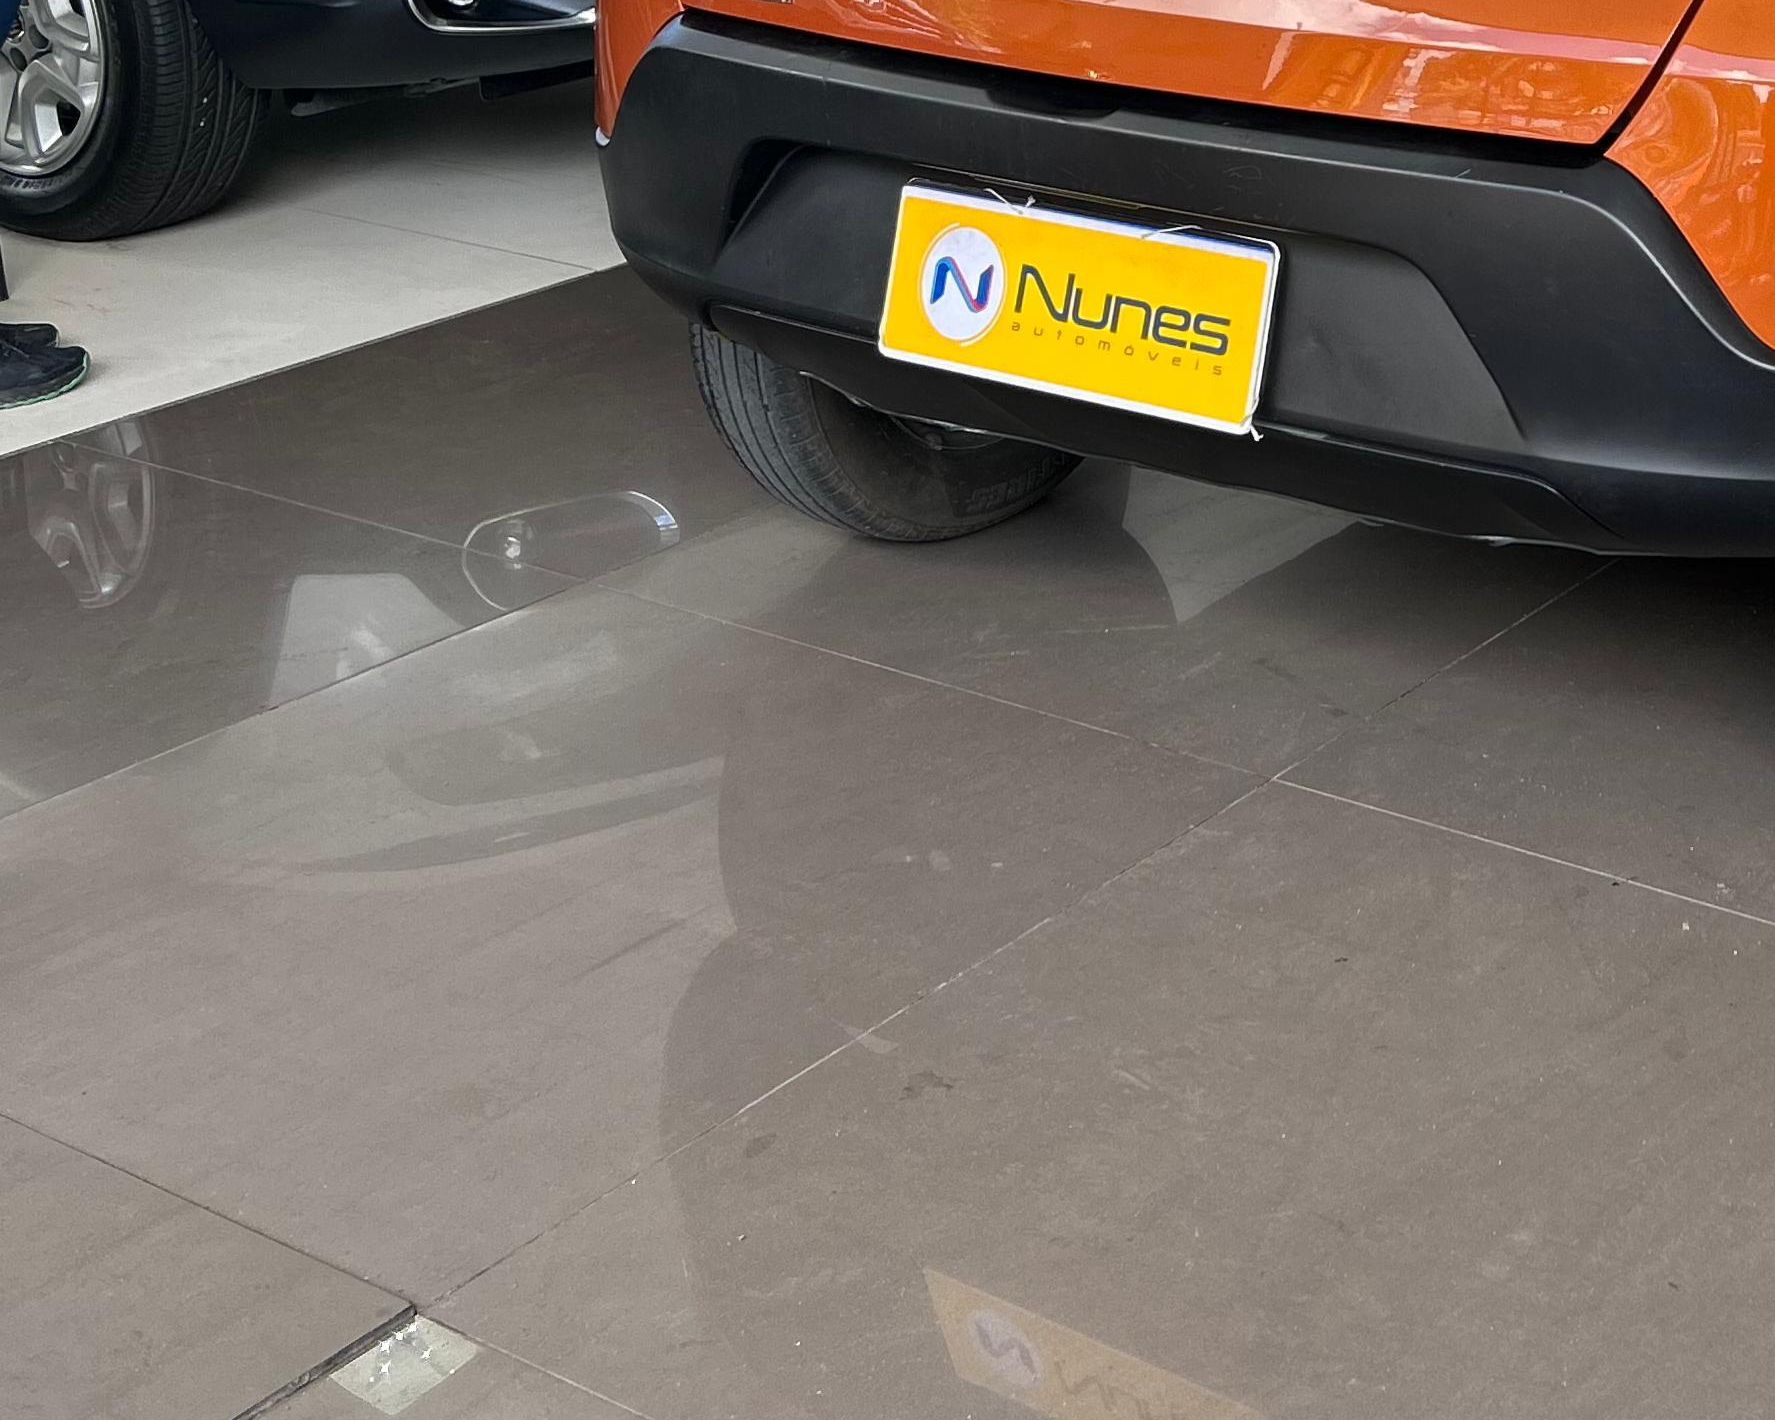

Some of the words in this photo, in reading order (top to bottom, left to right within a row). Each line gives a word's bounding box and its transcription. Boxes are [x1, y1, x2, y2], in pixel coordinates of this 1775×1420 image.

[930, 256, 994, 313] N
[1014, 263, 1231, 357] Nunes
[1011, 320, 1223, 377] automóveis
